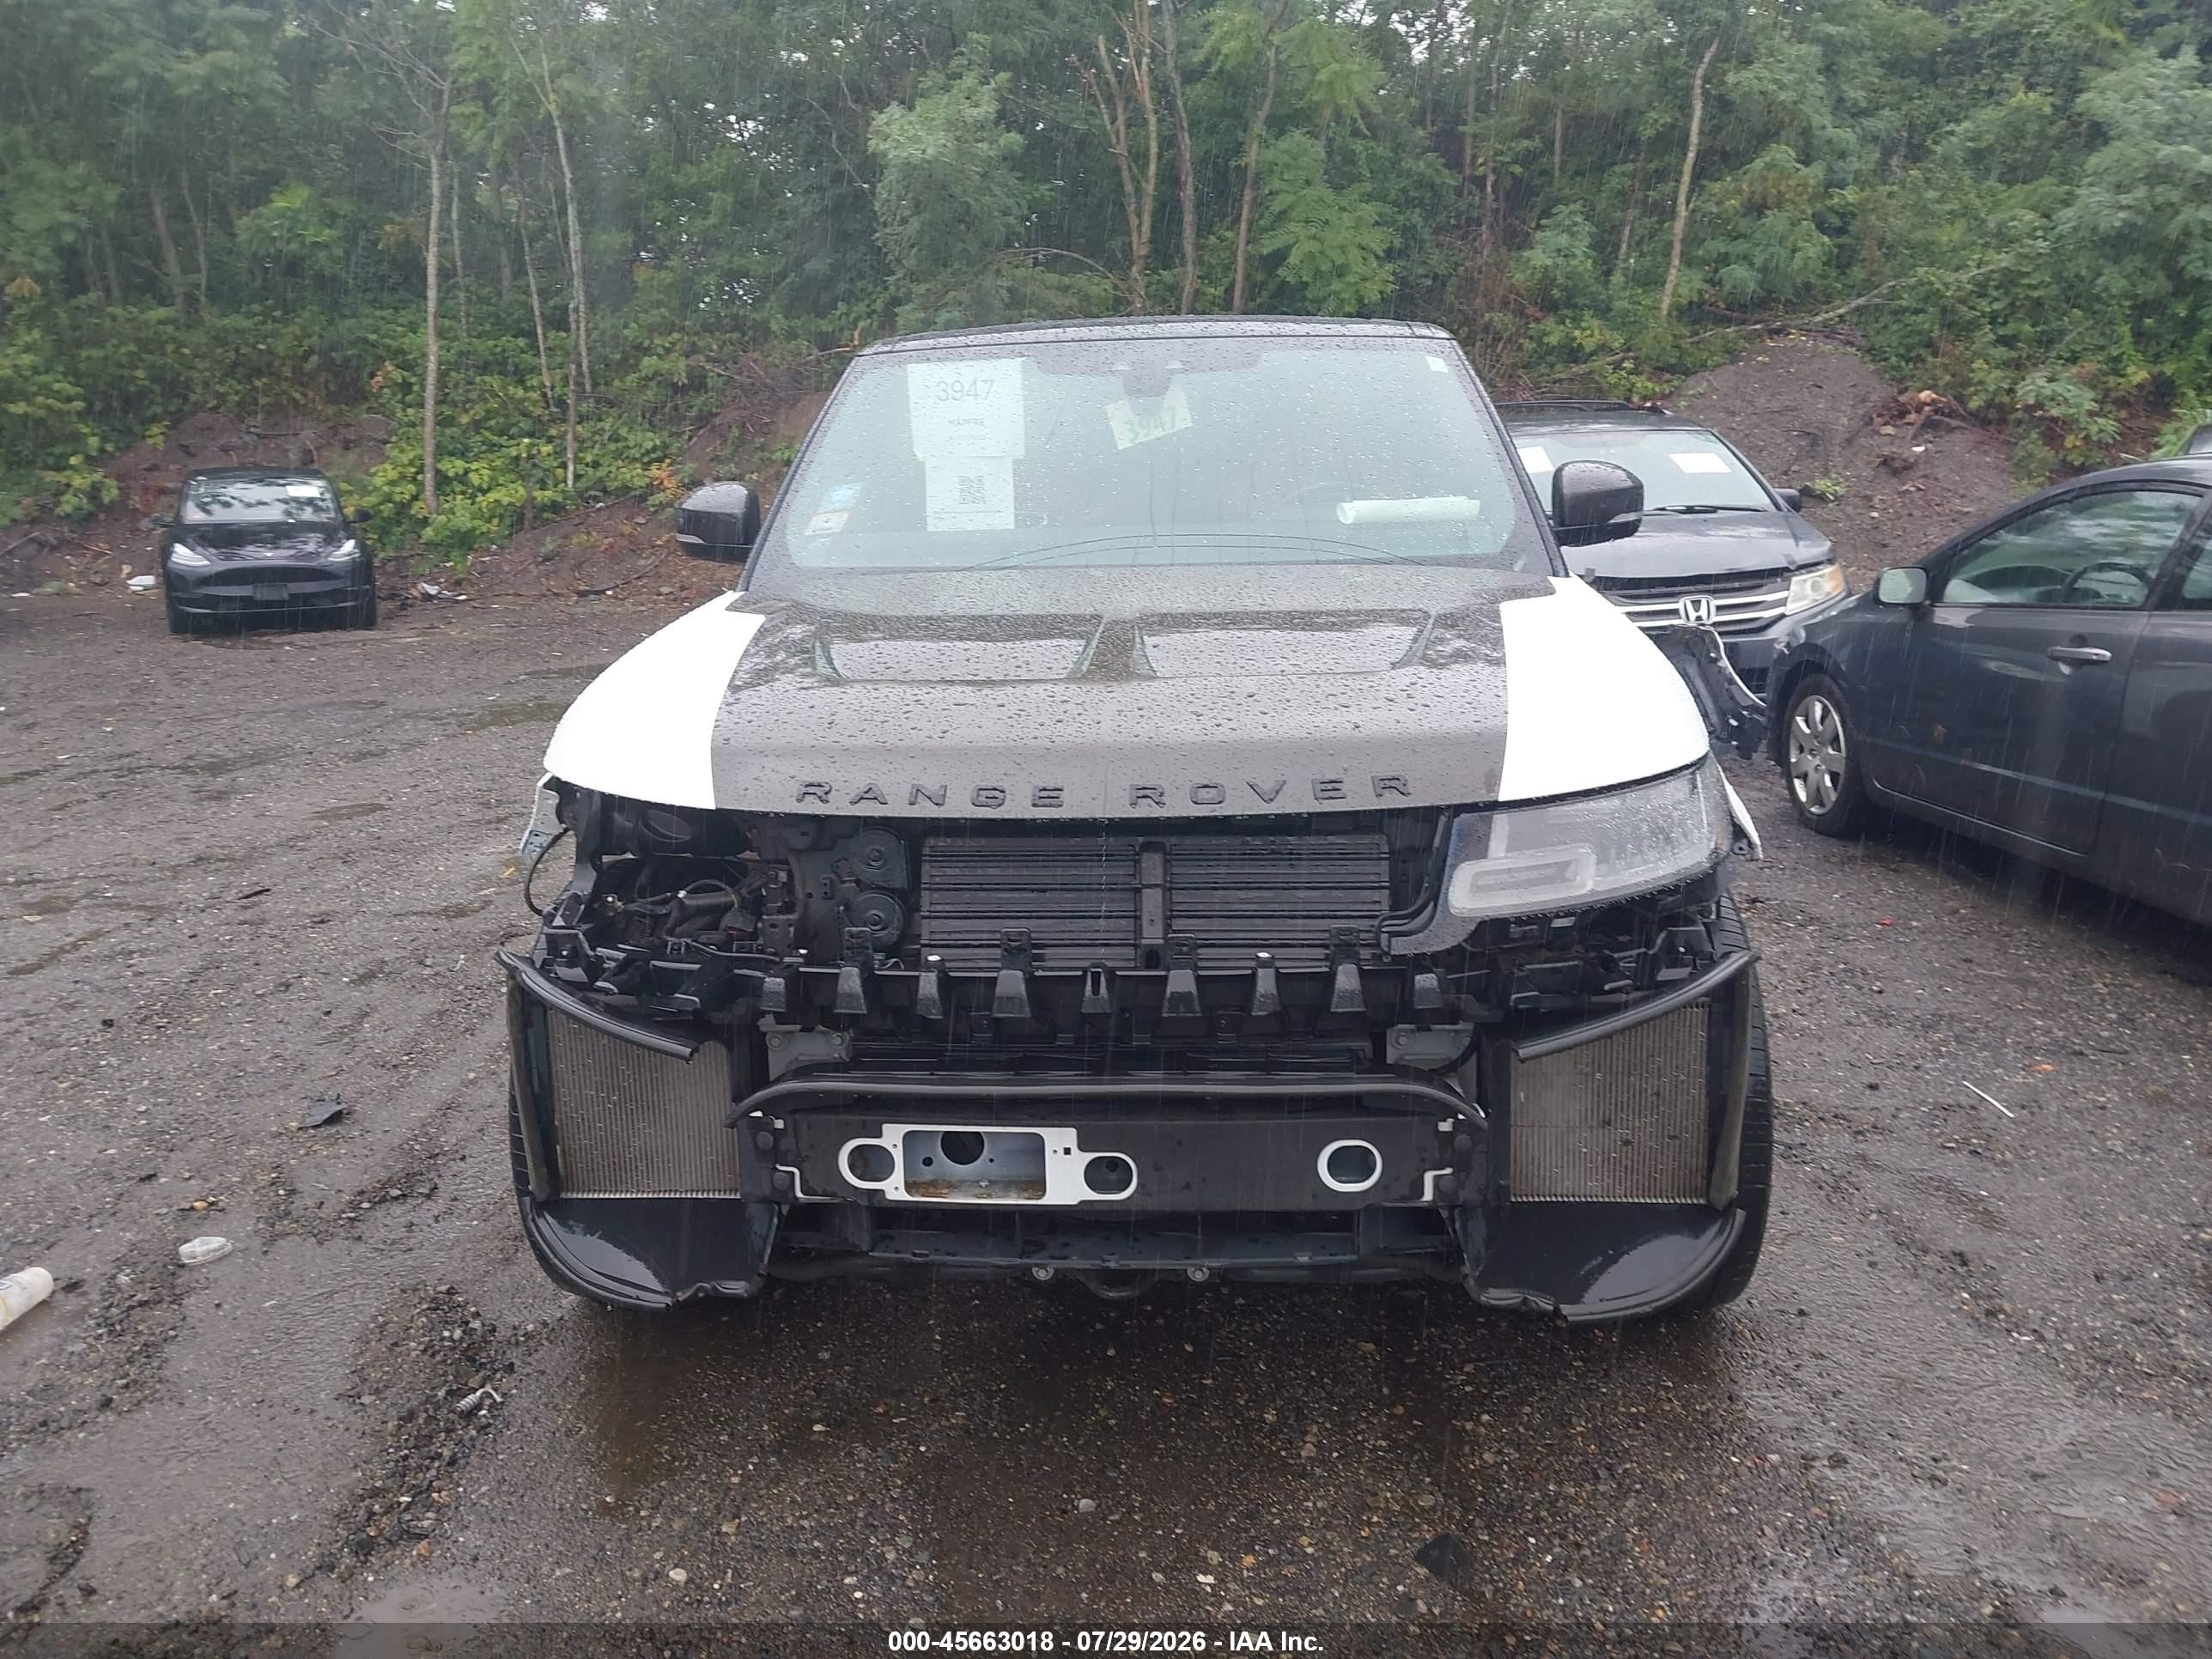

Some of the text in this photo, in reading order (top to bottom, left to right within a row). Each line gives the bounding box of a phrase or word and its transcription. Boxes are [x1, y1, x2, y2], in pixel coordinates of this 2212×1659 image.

[936, 378, 994, 401] 3947
[795, 775, 1412, 809] RANGE ROVER
